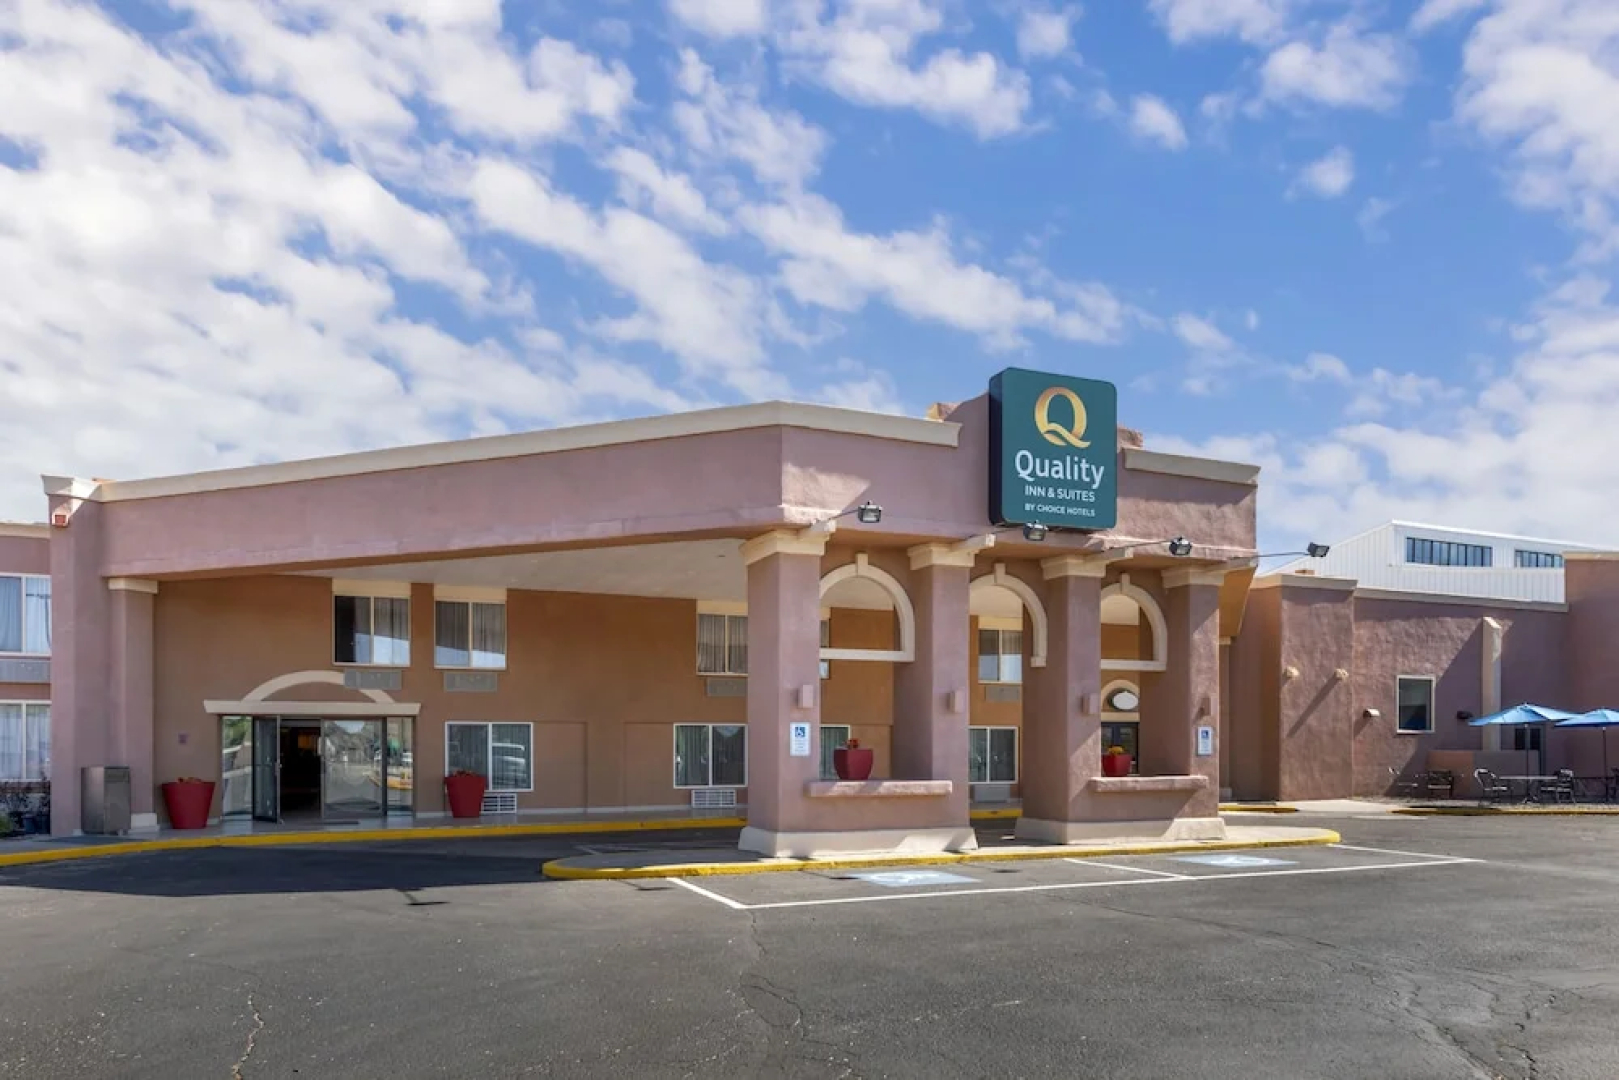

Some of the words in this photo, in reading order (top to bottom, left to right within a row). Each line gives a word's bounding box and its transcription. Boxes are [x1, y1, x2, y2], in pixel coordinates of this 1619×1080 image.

[1034, 386, 1091, 448] Q
[1015, 450, 1104, 489] Quality
[1025, 485, 1045, 497] INN
[1047, 486, 1055, 498] &
[1057, 488, 1095, 502] SUITES
[1025, 503, 1035, 511] BY
[1036, 504, 1065, 514] CHOICE
[1067, 507, 1095, 517] HOTELS
